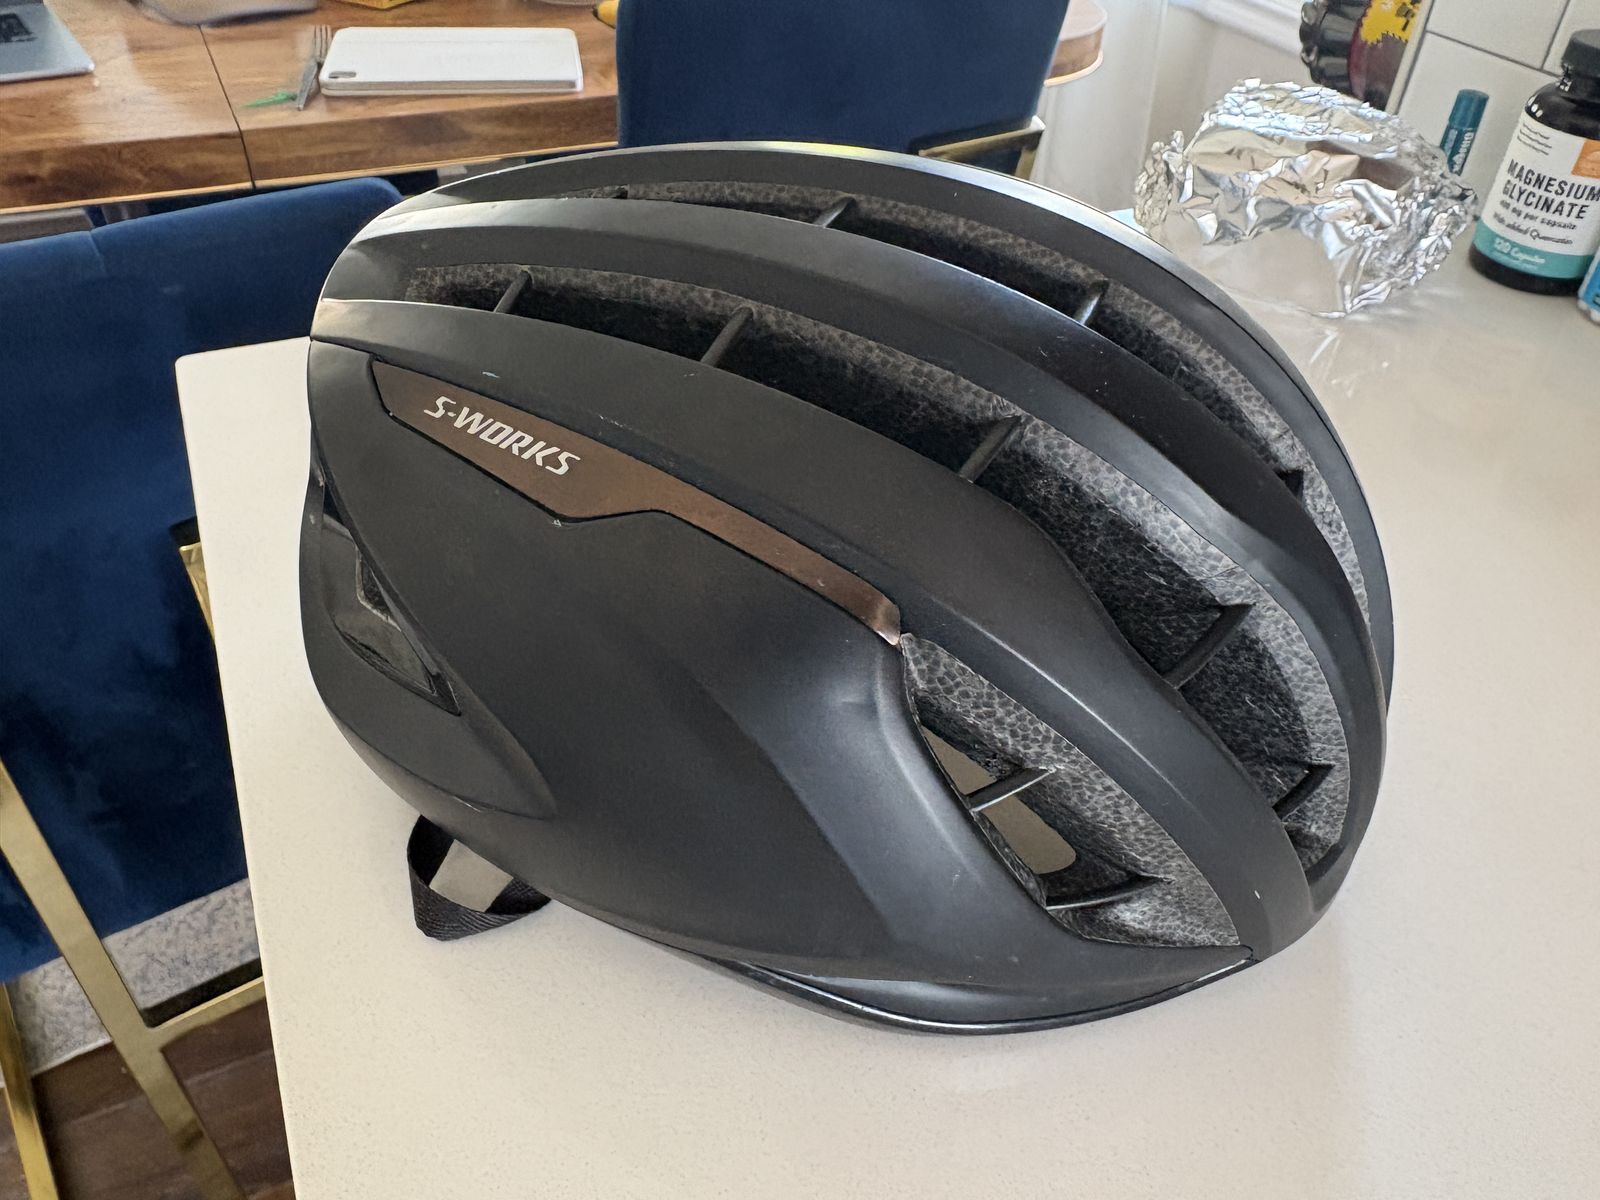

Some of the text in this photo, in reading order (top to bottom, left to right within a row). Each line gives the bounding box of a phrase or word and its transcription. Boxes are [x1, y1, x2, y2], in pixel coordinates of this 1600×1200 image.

[1502, 179, 1590, 220] GLYCINATE
[1507, 158, 1600, 202] MAGNESIUM
[423, 395, 581, 475] S-WORKS
